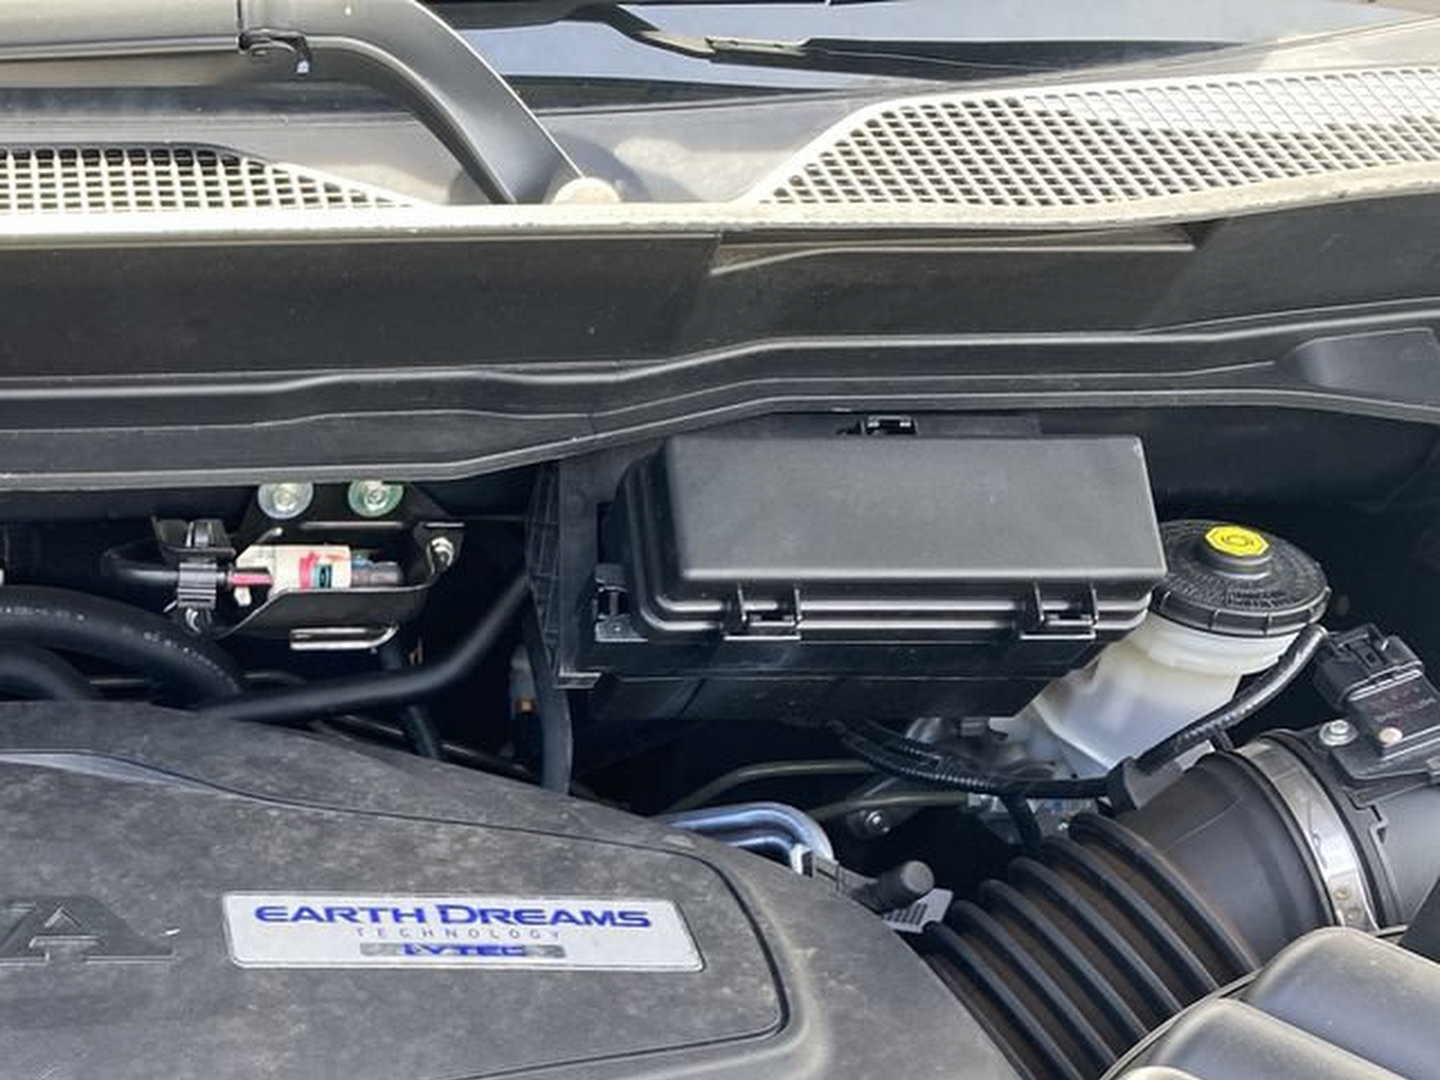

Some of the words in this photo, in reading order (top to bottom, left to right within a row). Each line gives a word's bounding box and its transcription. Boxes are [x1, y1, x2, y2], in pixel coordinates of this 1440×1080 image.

[254, 905, 425, 925] EARTH
[436, 904, 652, 928] DREAMS
[357, 927, 561, 940] TECHNOLOGY
